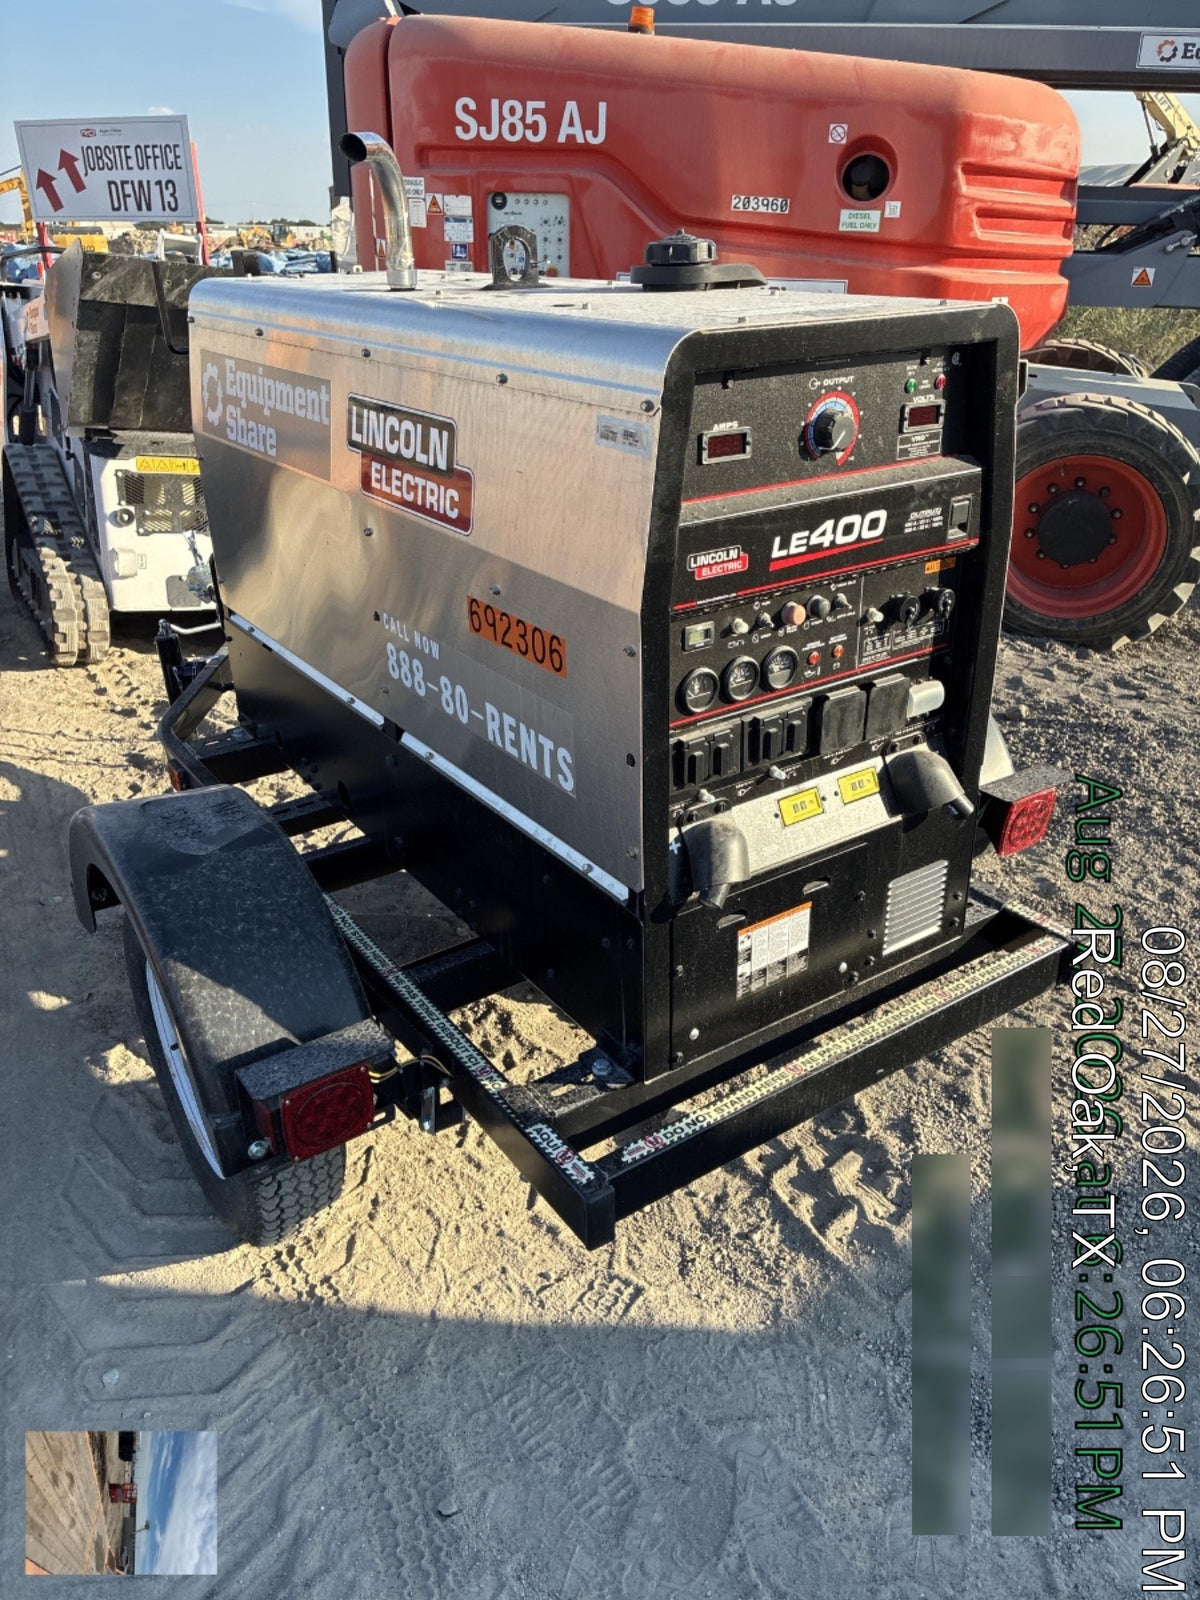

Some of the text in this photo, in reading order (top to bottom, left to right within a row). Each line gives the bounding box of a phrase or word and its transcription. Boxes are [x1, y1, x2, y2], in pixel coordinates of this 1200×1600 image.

[455, 97, 607, 144] SJ85 AJ
[81, 144, 182, 176] JOBSITE OFFICE
[107, 179, 178, 212] DFW 13
[733, 195, 788, 212] 203960
[225, 359, 330, 425] Equipment
[823, 376, 855, 386] OUTPUT
[225, 404, 277, 457] Share
[351, 406, 449, 470] LINCOLN
[713, 421, 738, 431] AMPS
[371, 461, 459, 520] ELECTRIC
[690, 548, 738, 569] LINCOLN
[771, 509, 887, 559] LE400
[701, 561, 742, 576] ELECTRIC
[383, 612, 440, 660] CALL NOW
[469, 598, 563, 673] 692306
[386, 642, 575, 792] 888-80-RENTS
[402, 985, 419, 999] PAS
[416, 998, 438, 1021] TENEZ
[437, 1021, 470, 1053] DEBOUT
[465, 1052, 480, 1067] ICI
[802, 1054, 817, 1066] NE
[842, 1025, 877, 1046] TENEZ
[877, 1004, 921, 1028] DEBOUT
[662, 1072, 788, 1140] DO NOT STAND HERE
[533, 1127, 561, 1152] AQUI
